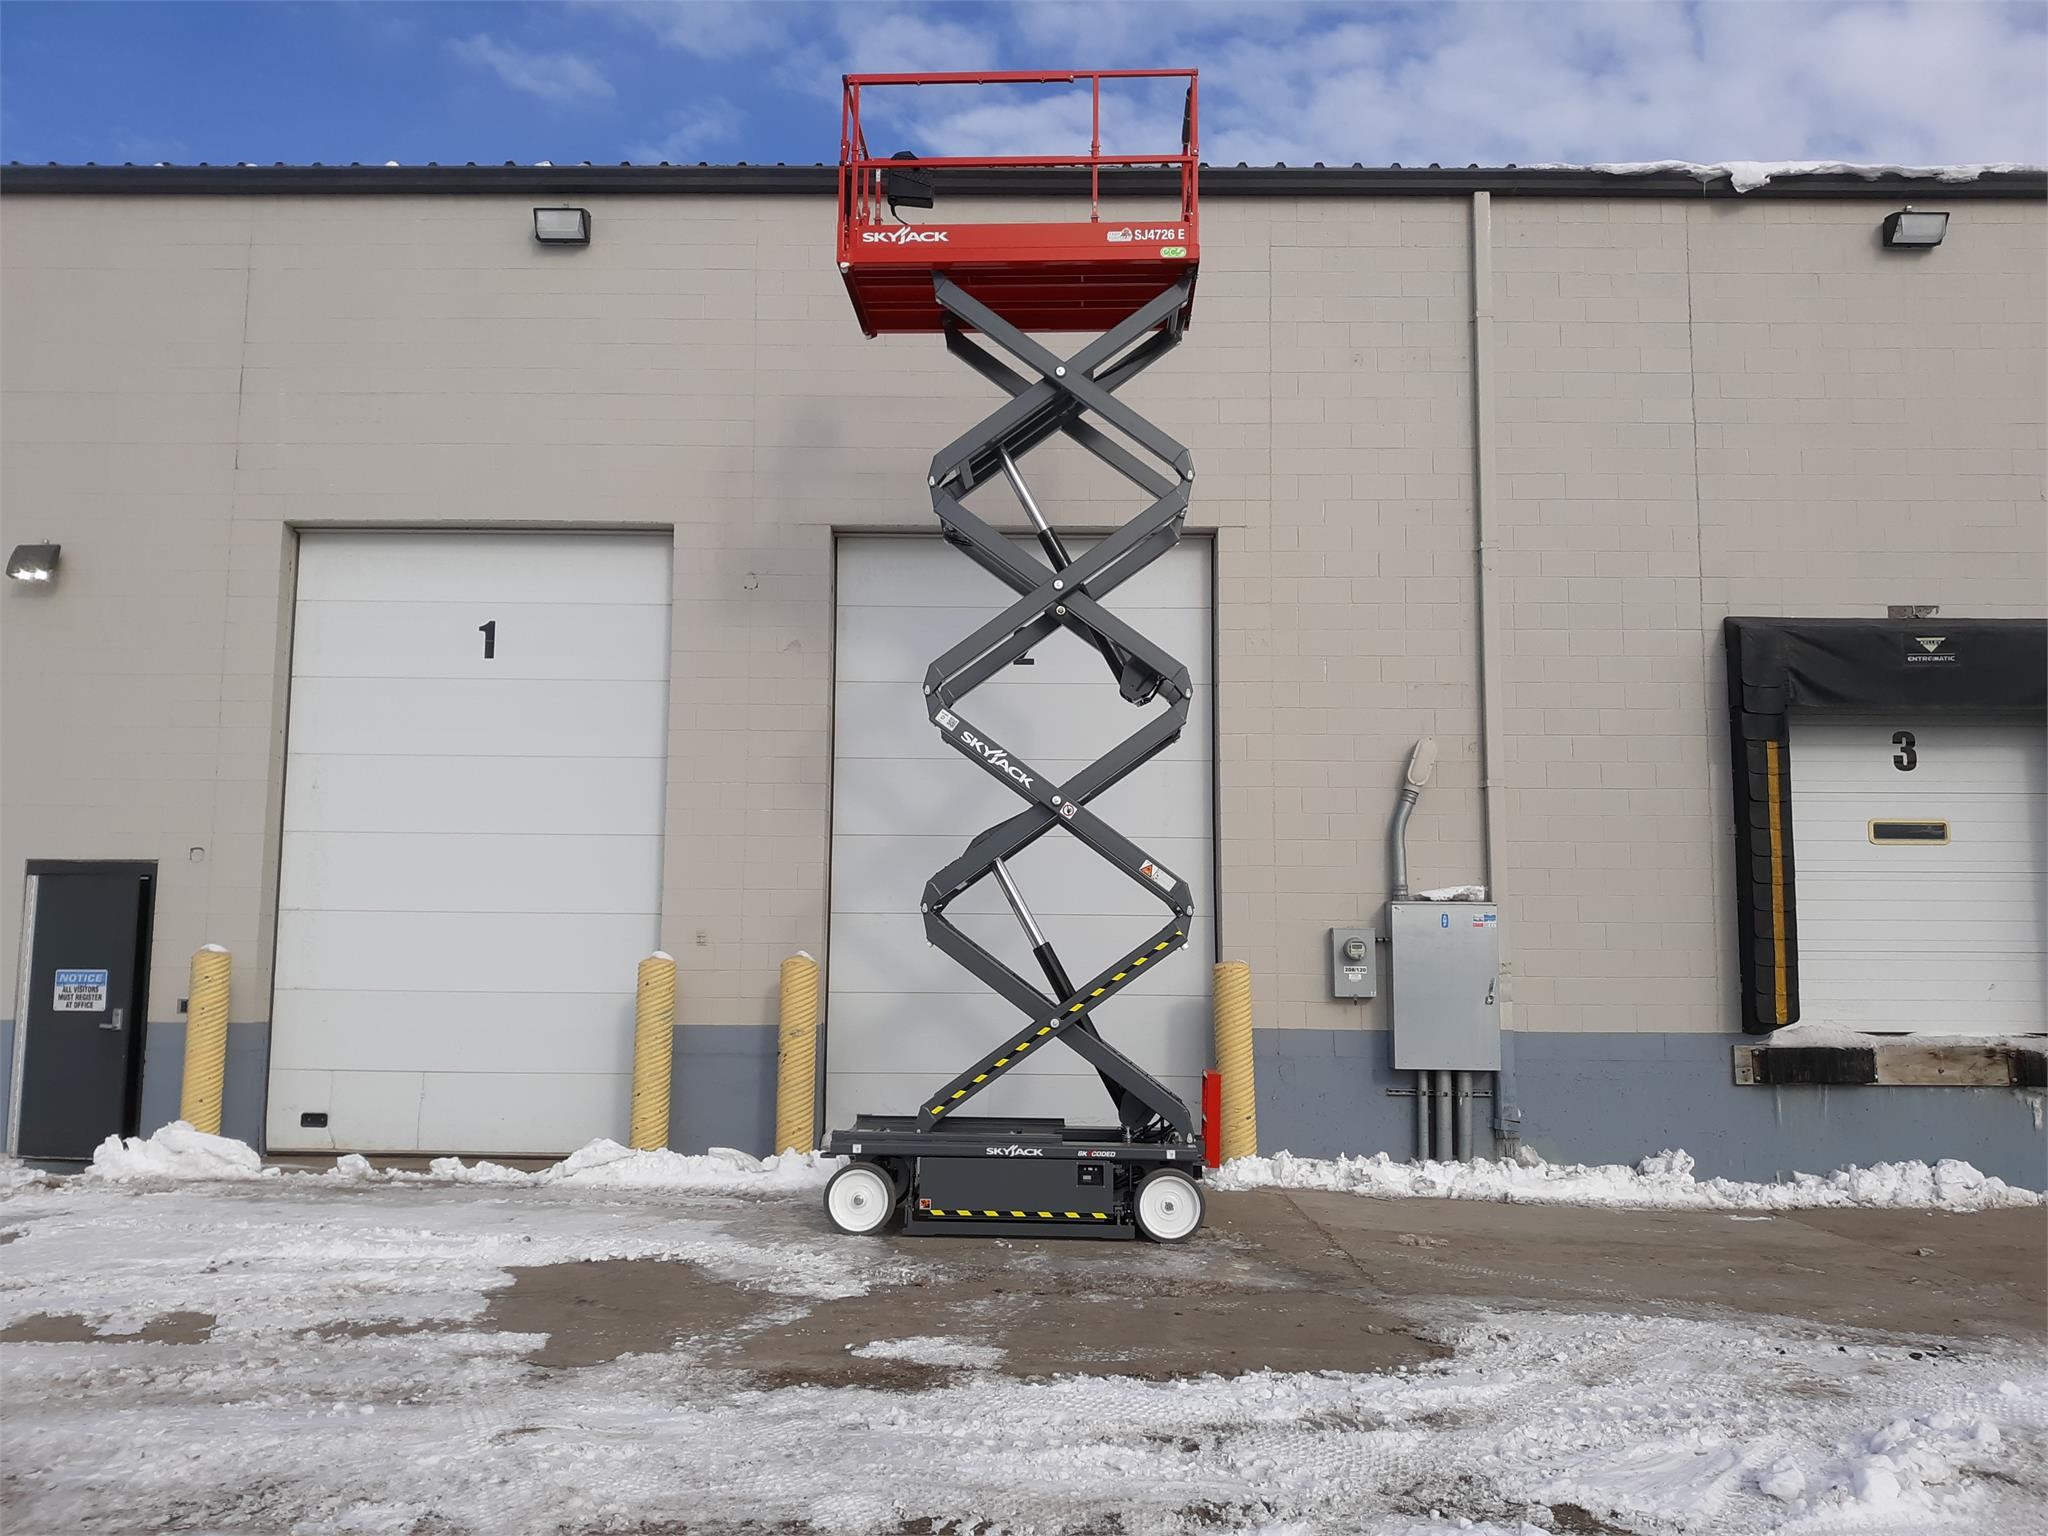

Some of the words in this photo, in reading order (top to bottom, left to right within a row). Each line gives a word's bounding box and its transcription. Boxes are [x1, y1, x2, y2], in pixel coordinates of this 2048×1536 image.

[862, 226, 949, 245] SKYJACK
[1134, 228, 1175, 241] SJ4726
[1178, 228, 1185, 240] E
[478, 620, 496, 659] 1
[1892, 731, 1917, 771] 3
[960, 731, 1034, 789] SKYJACK
[60, 973, 104, 983] NOTICE
[62, 985, 72, 993] ALL
[73, 985, 99, 993] VISITORS
[58, 993, 74, 1001] MUST
[75, 993, 102, 1001] REGISTER
[65, 1001, 73, 1009] AT
[73, 1001, 93, 1009] OFFICE
[985, 1144, 1044, 1157] SKYJACK
